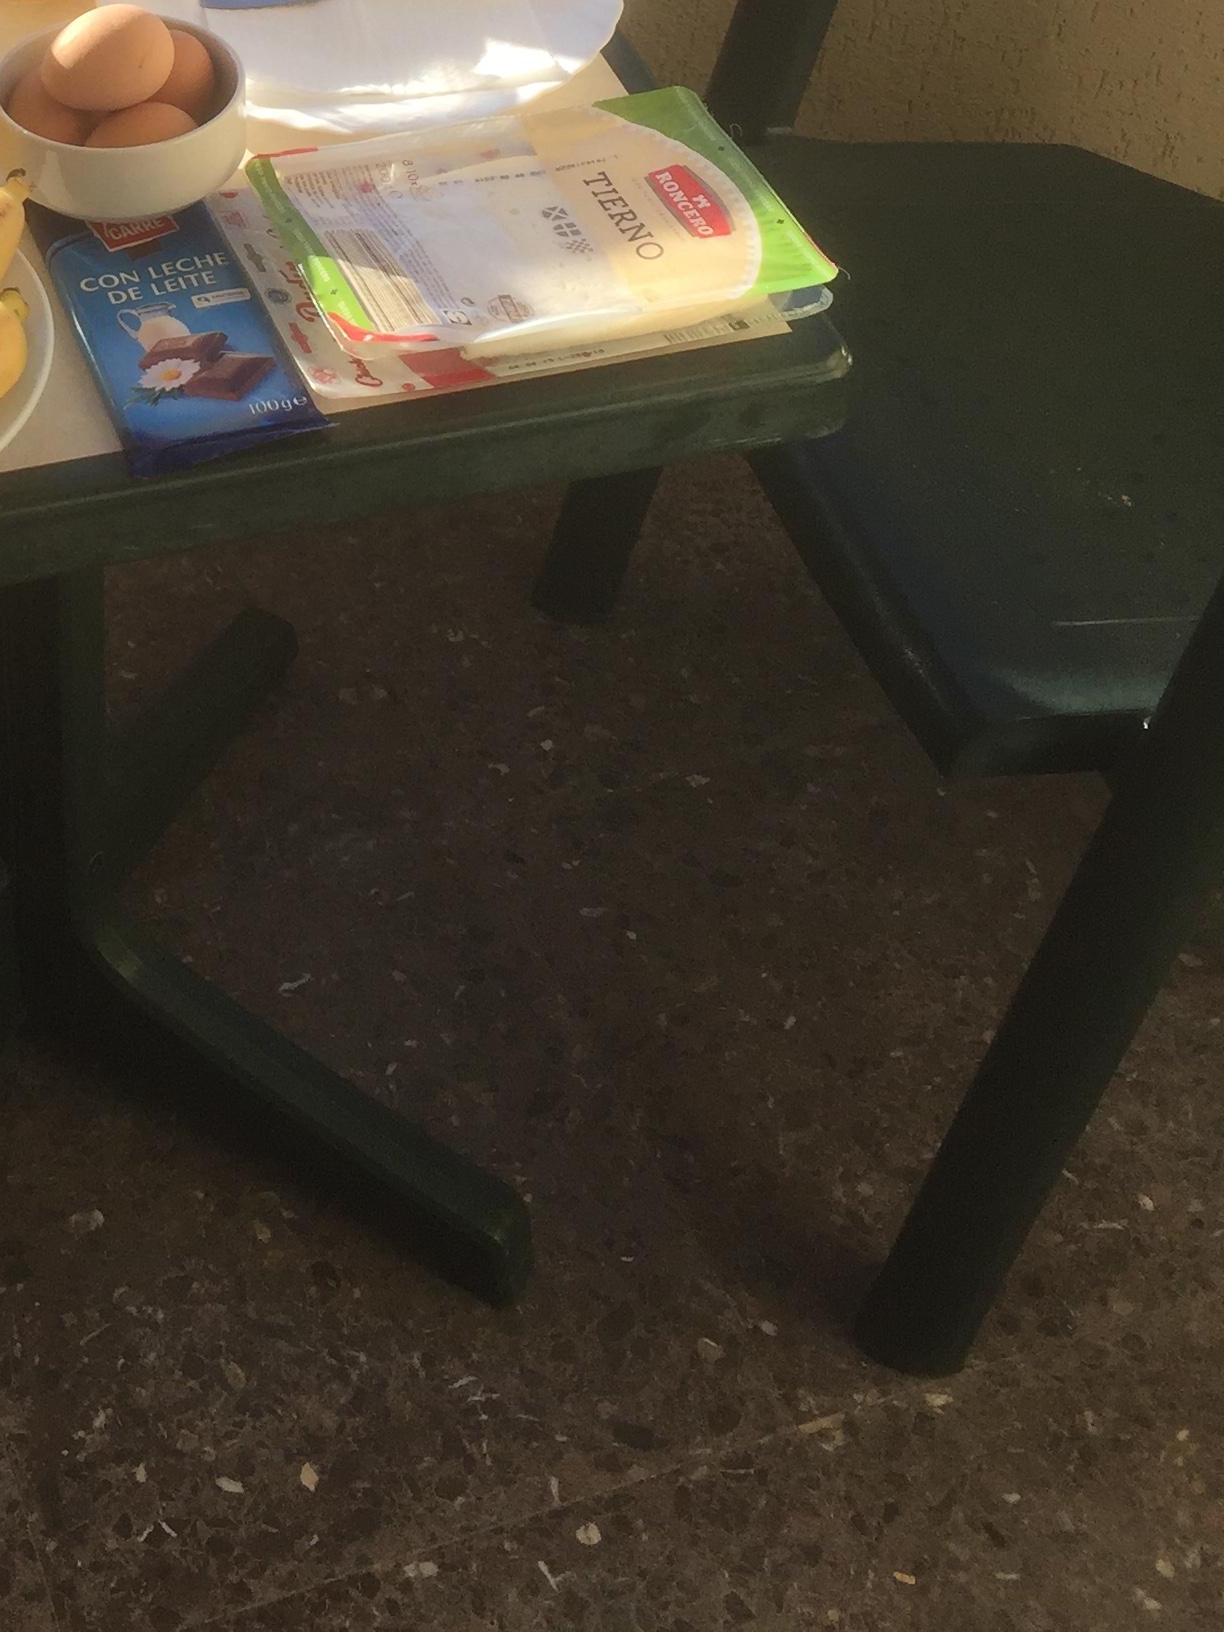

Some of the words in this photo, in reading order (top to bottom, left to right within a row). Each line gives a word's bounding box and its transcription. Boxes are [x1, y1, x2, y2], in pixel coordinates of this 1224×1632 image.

[582, 170, 664, 260] TIERNO
[655, 171, 714, 236] RONCERO
[80, 270, 141, 292] CON
[148, 252, 229, 280] LECHE
[107, 286, 143, 305] DE
[150, 270, 216, 296] LEITE
